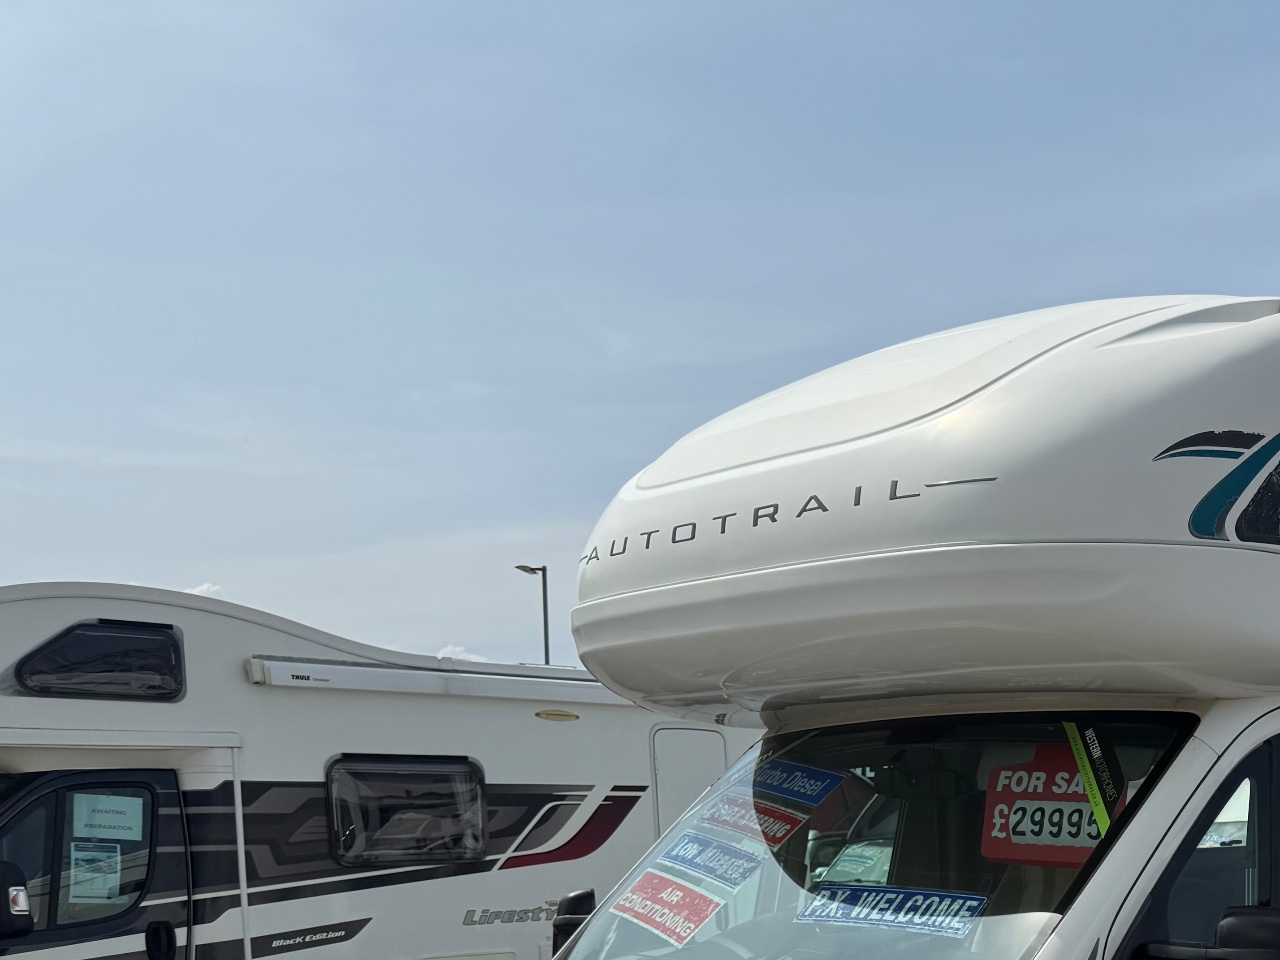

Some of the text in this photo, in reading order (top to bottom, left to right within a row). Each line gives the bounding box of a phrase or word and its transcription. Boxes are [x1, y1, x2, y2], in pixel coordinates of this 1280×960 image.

[585, 479, 921, 566] AUTOTRAIL
[783, 771, 831, 796] Diesel
[995, 770, 1088, 795] FOR SA
[91, 807, 127, 816] AWAITING
[83, 822, 133, 832] PREPARATION
[658, 884, 684, 905] AIR
[618, 892, 696, 938] CONDITIONING
[850, 891, 980, 928] WELCOME
[304, 930, 346, 942] Edition
